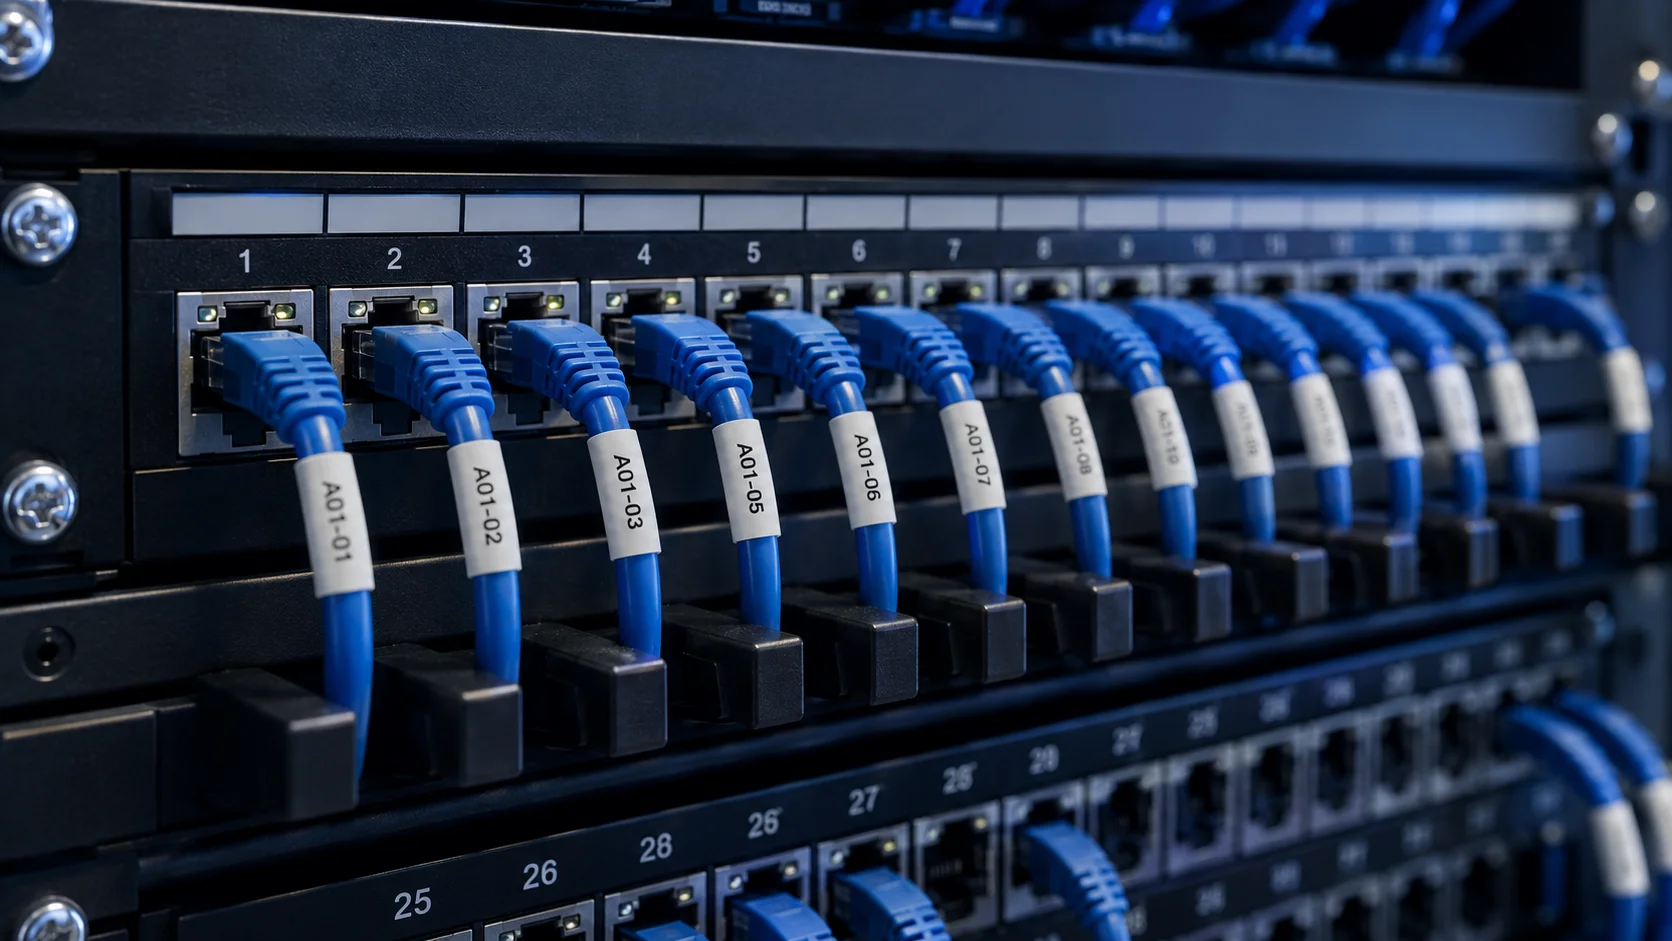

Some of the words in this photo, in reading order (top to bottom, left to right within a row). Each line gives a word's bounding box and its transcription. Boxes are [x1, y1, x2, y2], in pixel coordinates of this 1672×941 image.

[238, 248, 250, 274] 1
[387, 247, 402, 270] 2
[517, 244, 532, 268] 3
[636, 242, 652, 266] 4
[747, 240, 761, 264] 5
[851, 239, 867, 262] 6
[947, 237, 962, 260] 7
[853, 434, 881, 501] A01-06
[964, 422, 991, 486] A01-07
[613, 454, 643, 530] A01-03
[736, 442, 764, 514] A01-05
[322, 481, 353, 562] A01-01
[473, 467, 502, 546] A01-02
[848, 785, 881, 816] 27
[639, 832, 673, 863] 28
[522, 859, 558, 891] 26
[394, 887, 432, 921] 25
